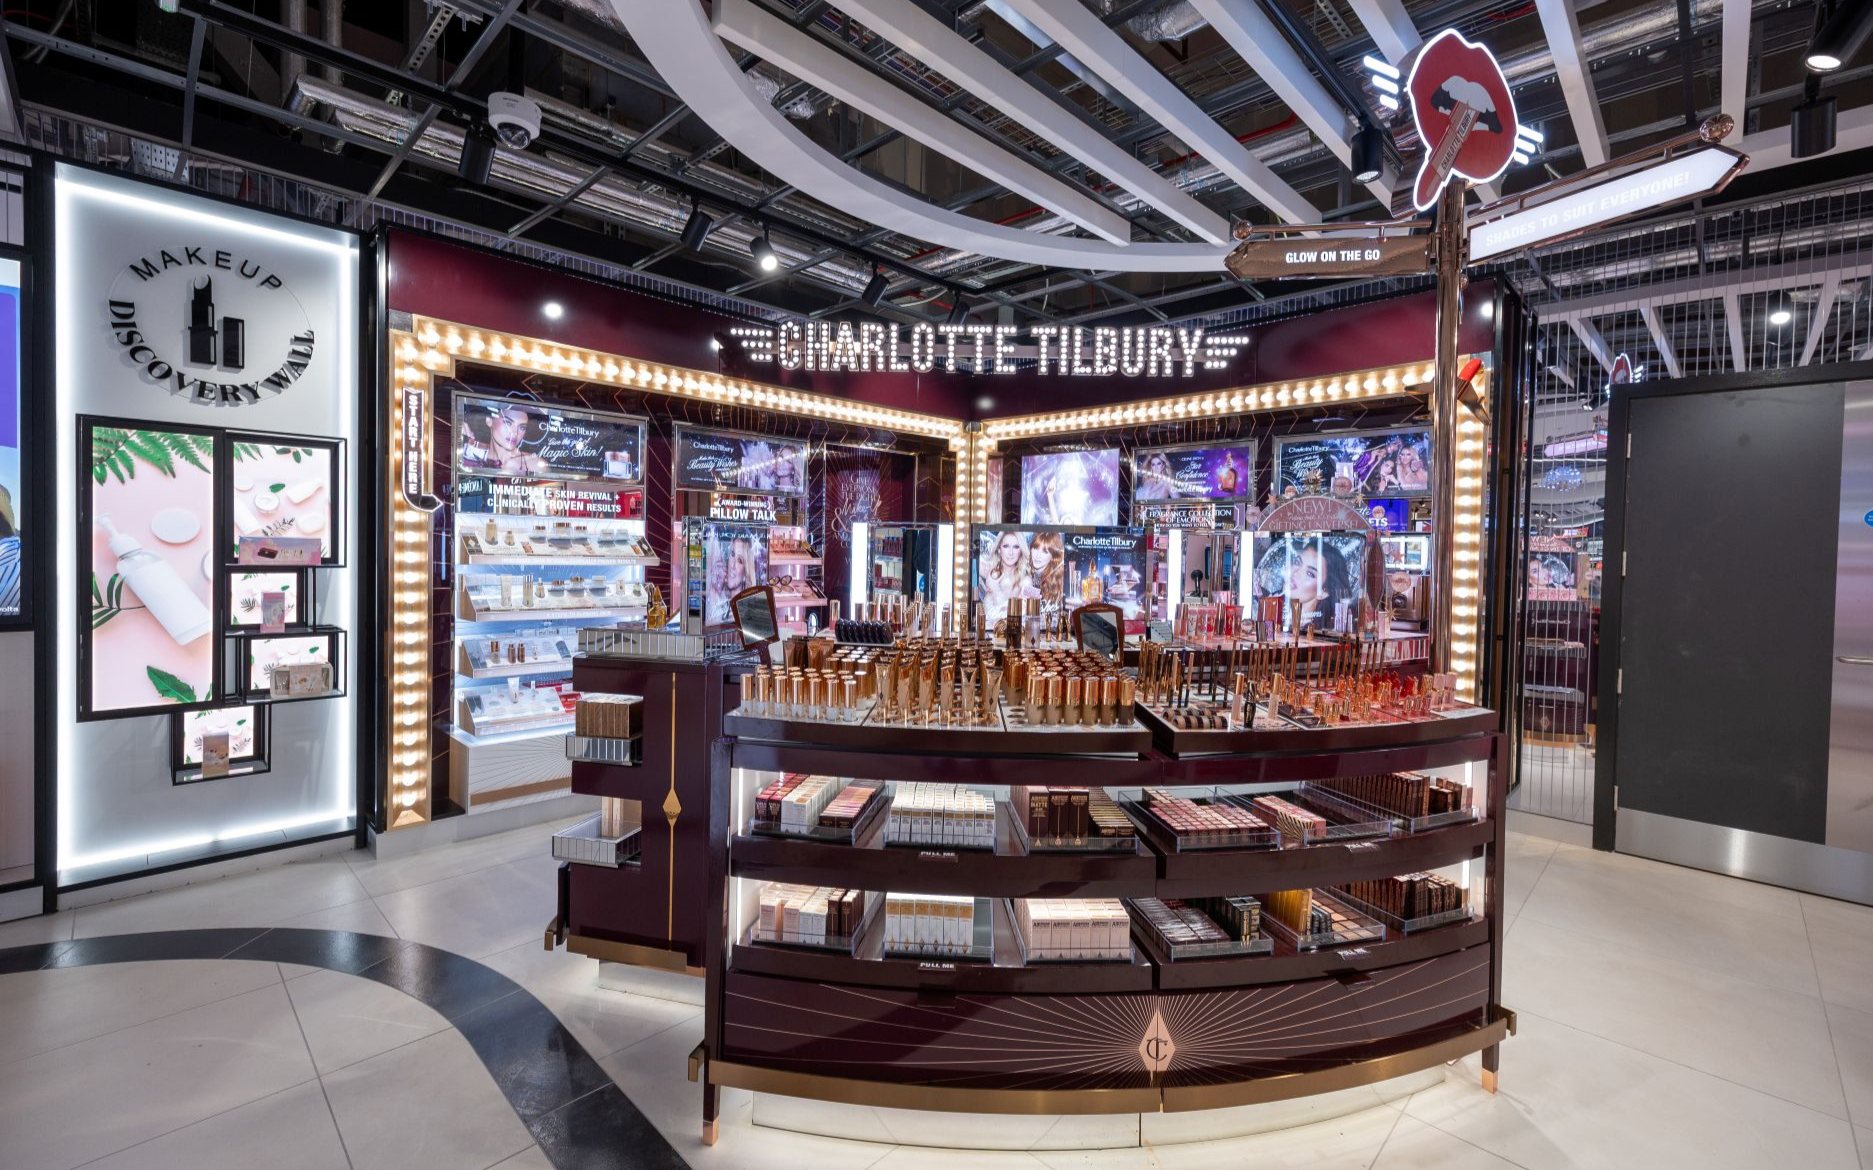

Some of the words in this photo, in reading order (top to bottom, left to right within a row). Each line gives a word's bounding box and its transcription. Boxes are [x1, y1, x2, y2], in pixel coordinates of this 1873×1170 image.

[1441, 136, 1460, 170] CHARLOTTE
[1458, 113, 1472, 137] TILBURY
[1485, 222, 1536, 247] SHADES
[1541, 213, 1558, 229] TO
[1562, 201, 1596, 223] SUIT
[1599, 171, 1690, 211] EVERYONE!
[1285, 251, 1318, 264] GLOW
[1320, 250, 1337, 263] ON
[1340, 250, 1361, 262] THE
[1364, 249, 1381, 261] GO
[129, 247, 282, 289] MAKEUP
[109, 299, 261, 402] DISCOVERY
[264, 330, 315, 390] WALL
[777, 321, 1017, 375] CHARLOTTE
[1030, 325, 1204, 377] TILBURY
[408, 394, 418, 448] START
[538, 445, 570, 463] Magic
[408, 451, 418, 494] HERE
[488, 480, 553, 499] IMMEDIATE
[555, 490, 576, 500] SKIN
[578, 491, 612, 501] REVIVAL
[544, 499, 584, 511] PROVEN
[586, 502, 622, 513] RESULTS
[721, 499, 767, 509] AWARD-WINNING
[1292, 499, 1332, 514] NEW!
[709, 507, 749, 520] PILLOW
[751, 509, 777, 521] TALK
[1149, 510, 1187, 518] FRAGRANCE
[1268, 520, 1307, 531] GIFTING
